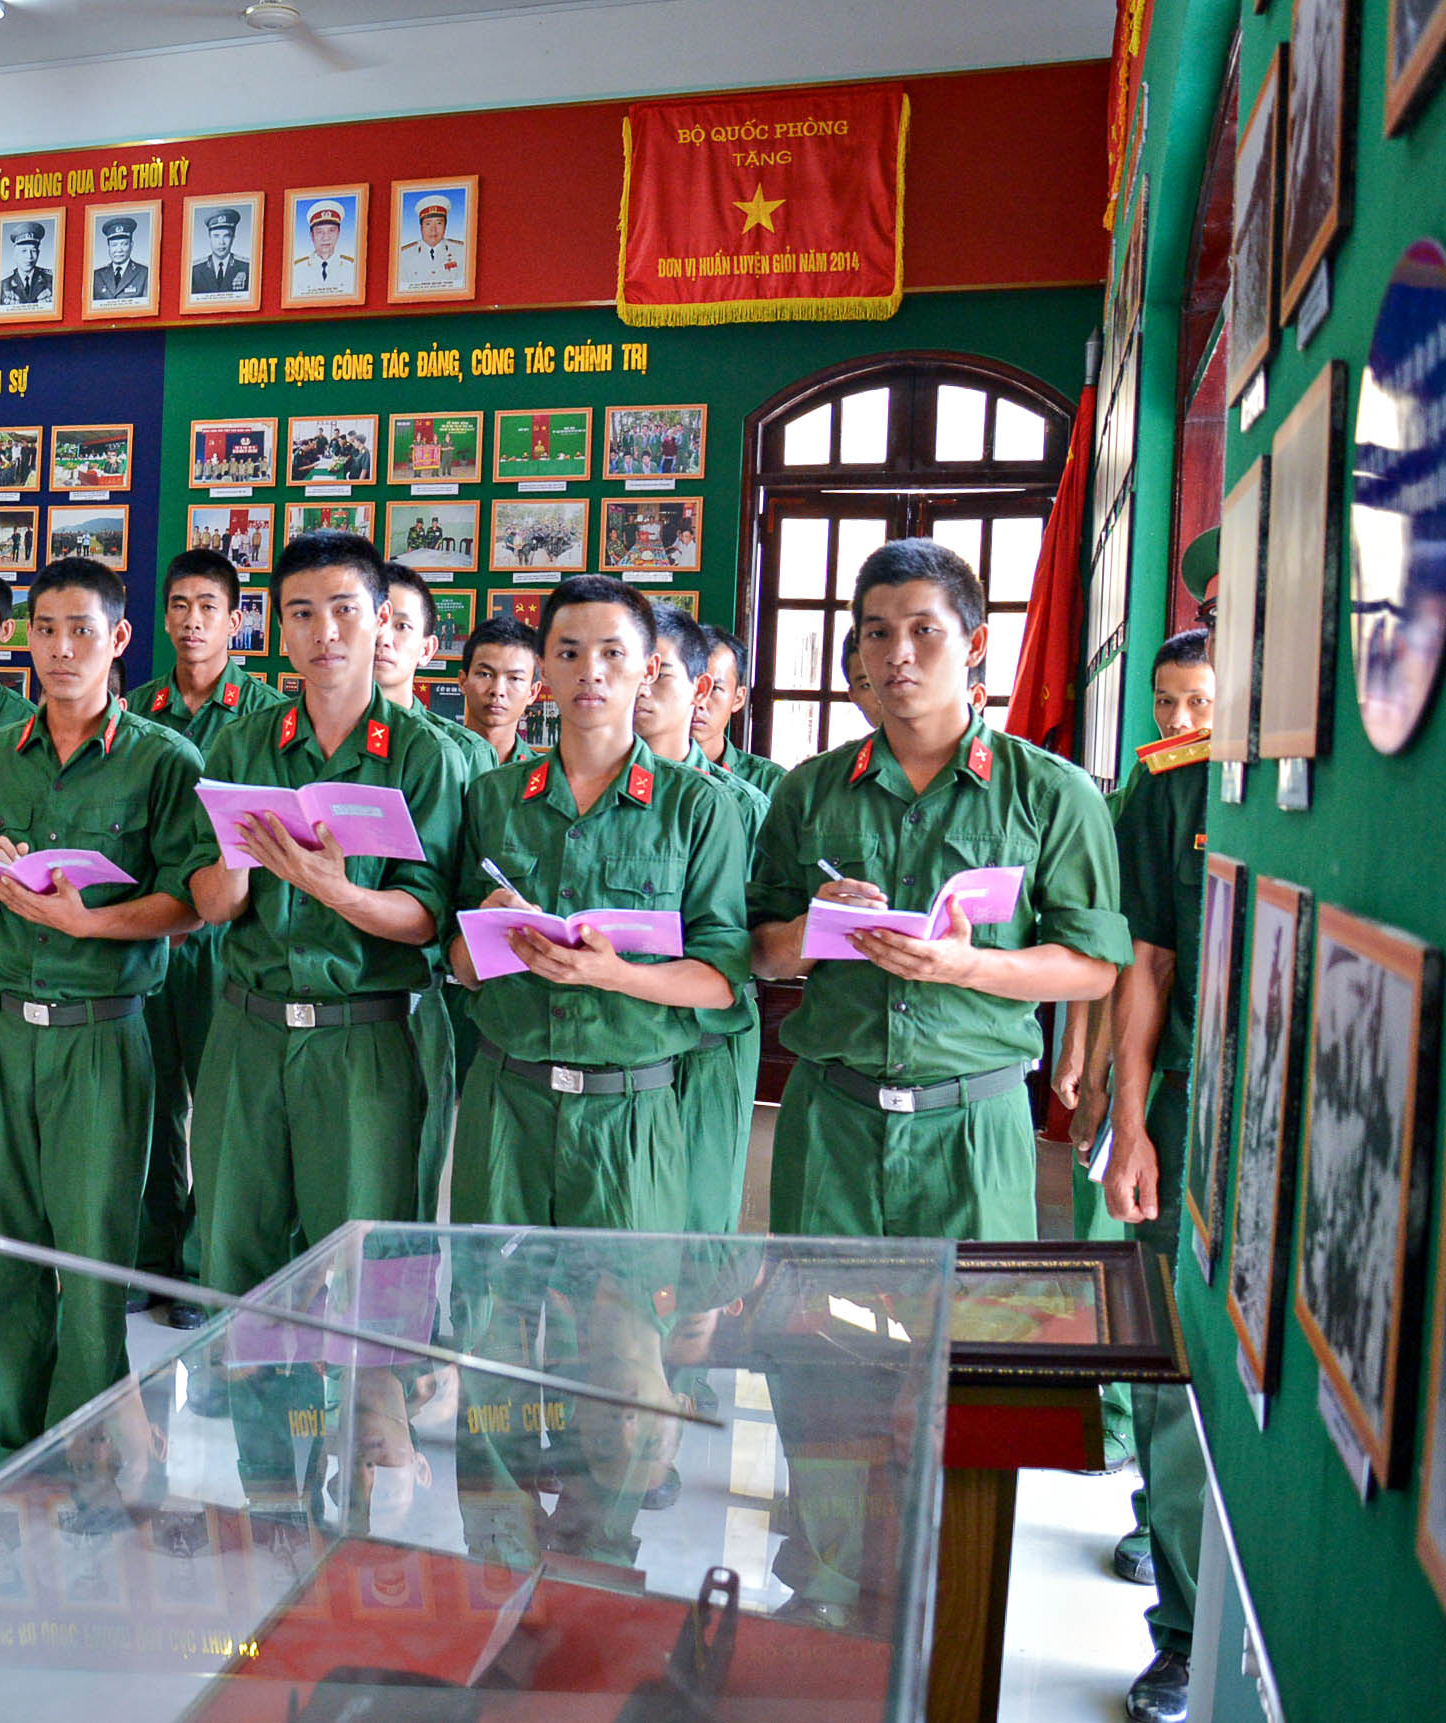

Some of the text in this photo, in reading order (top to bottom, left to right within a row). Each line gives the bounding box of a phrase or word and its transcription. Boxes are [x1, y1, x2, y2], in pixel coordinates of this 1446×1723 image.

[677, 116, 849, 147] BỘ QUỐC PHÒNG
[732, 150, 792, 168] TẶNG
[15, 168, 63, 200] PHÒNG
[67, 169, 95, 197] QUA
[99, 161, 128, 192] CÁC
[131, 156, 163, 189] THỜI
[169, 156, 189, 187] KỲ
[658, 245, 860, 281] ĐƠN VỊ HUẤN LUYỆN GIỎI NĂM 2014
[238, 339, 648, 388] HOẠT ĐỘNG CÔNG TÁC ĐẢNG, CÔNG TÁC CHÍNH TRỊ
[9, 365, 29, 397] SỰ
